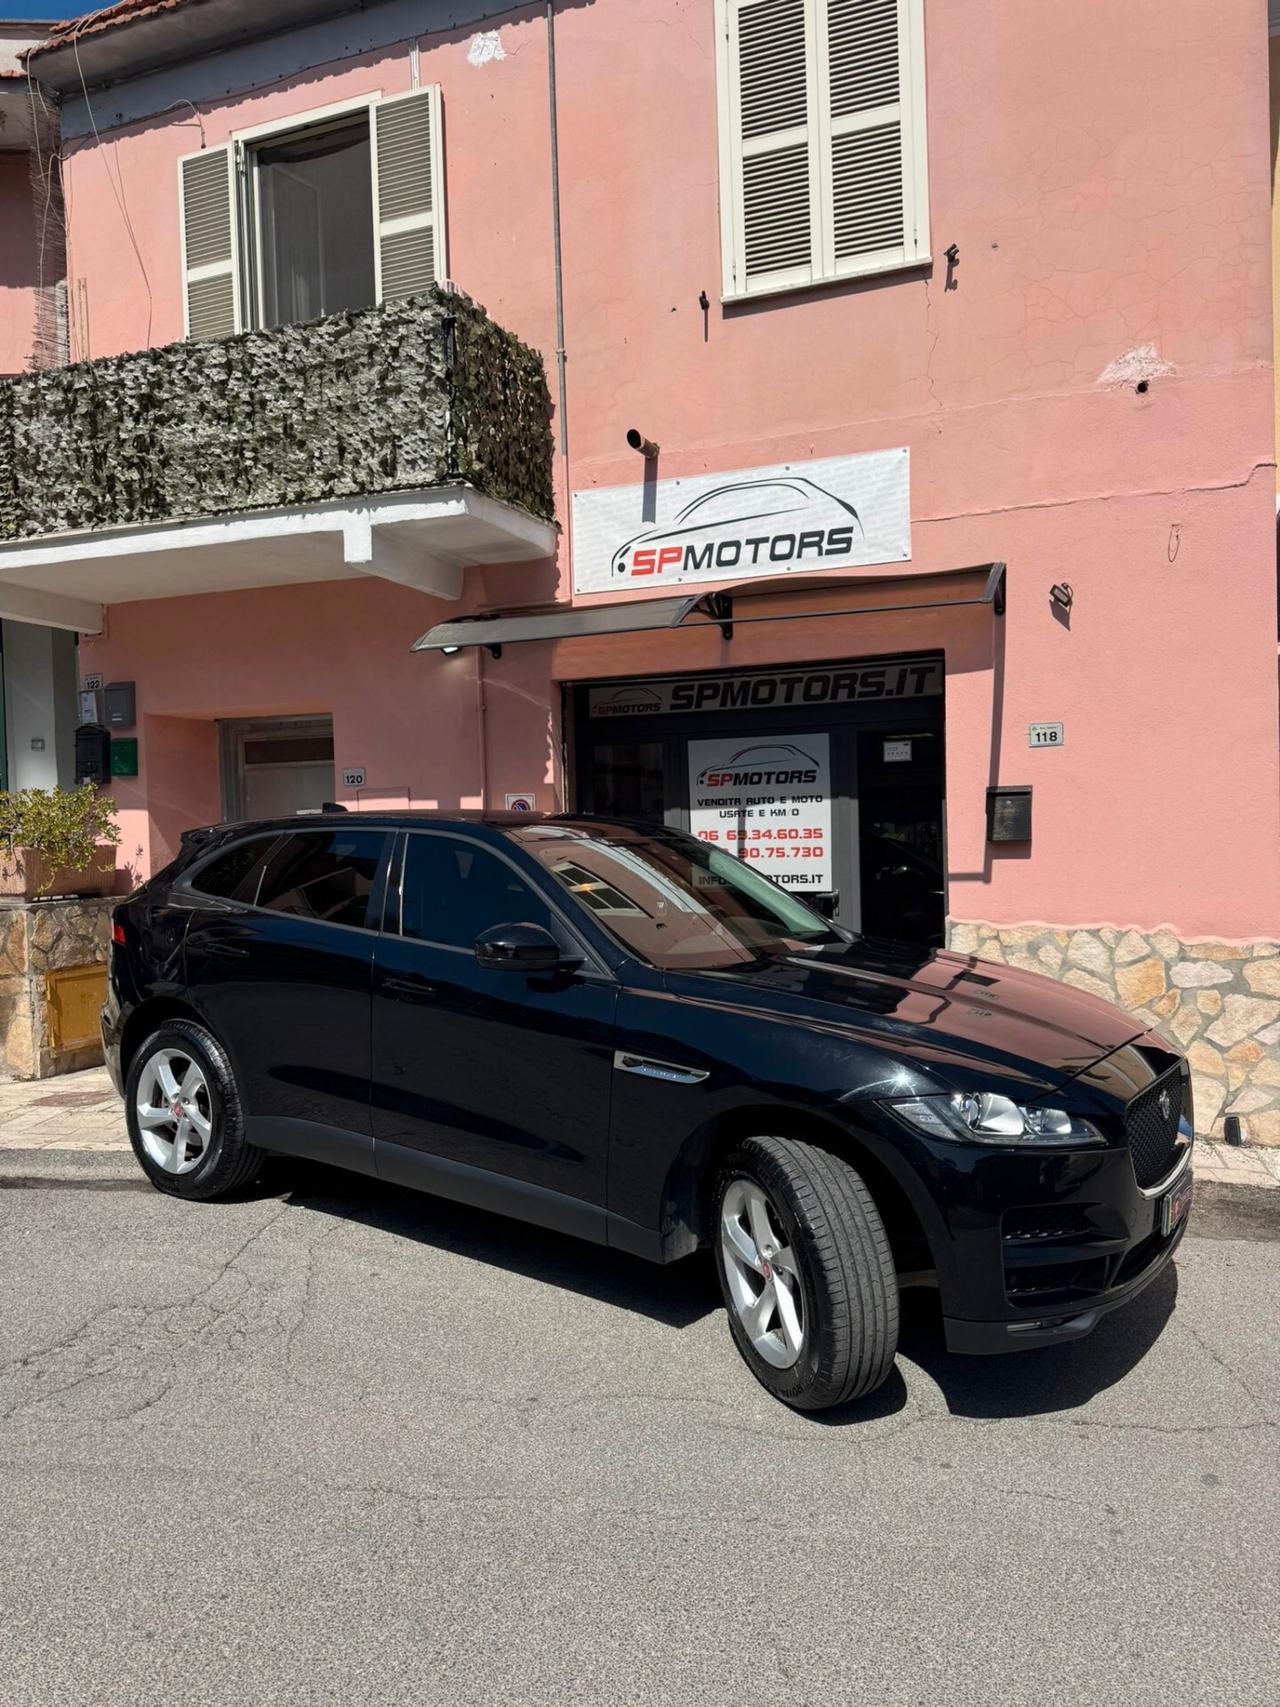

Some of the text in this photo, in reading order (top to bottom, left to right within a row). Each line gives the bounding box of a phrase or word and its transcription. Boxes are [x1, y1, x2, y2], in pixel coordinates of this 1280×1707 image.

[631, 526, 854, 577] SPMOTORS
[87, 680, 100, 689] 122
[669, 665, 936, 711] SPMOTORS.IT
[598, 703, 662, 715] SPMOTORS
[1035, 731, 1058, 742] 118
[346, 775, 363, 784] 120
[706, 769, 817, 787] SPMOTORS
[697, 795, 823, 807] VENDITA AUTO E MOTO
[719, 809, 754, 818] USATE
[759, 809, 765, 817] E
[698, 828, 824, 841] 06 69.34.60.35
